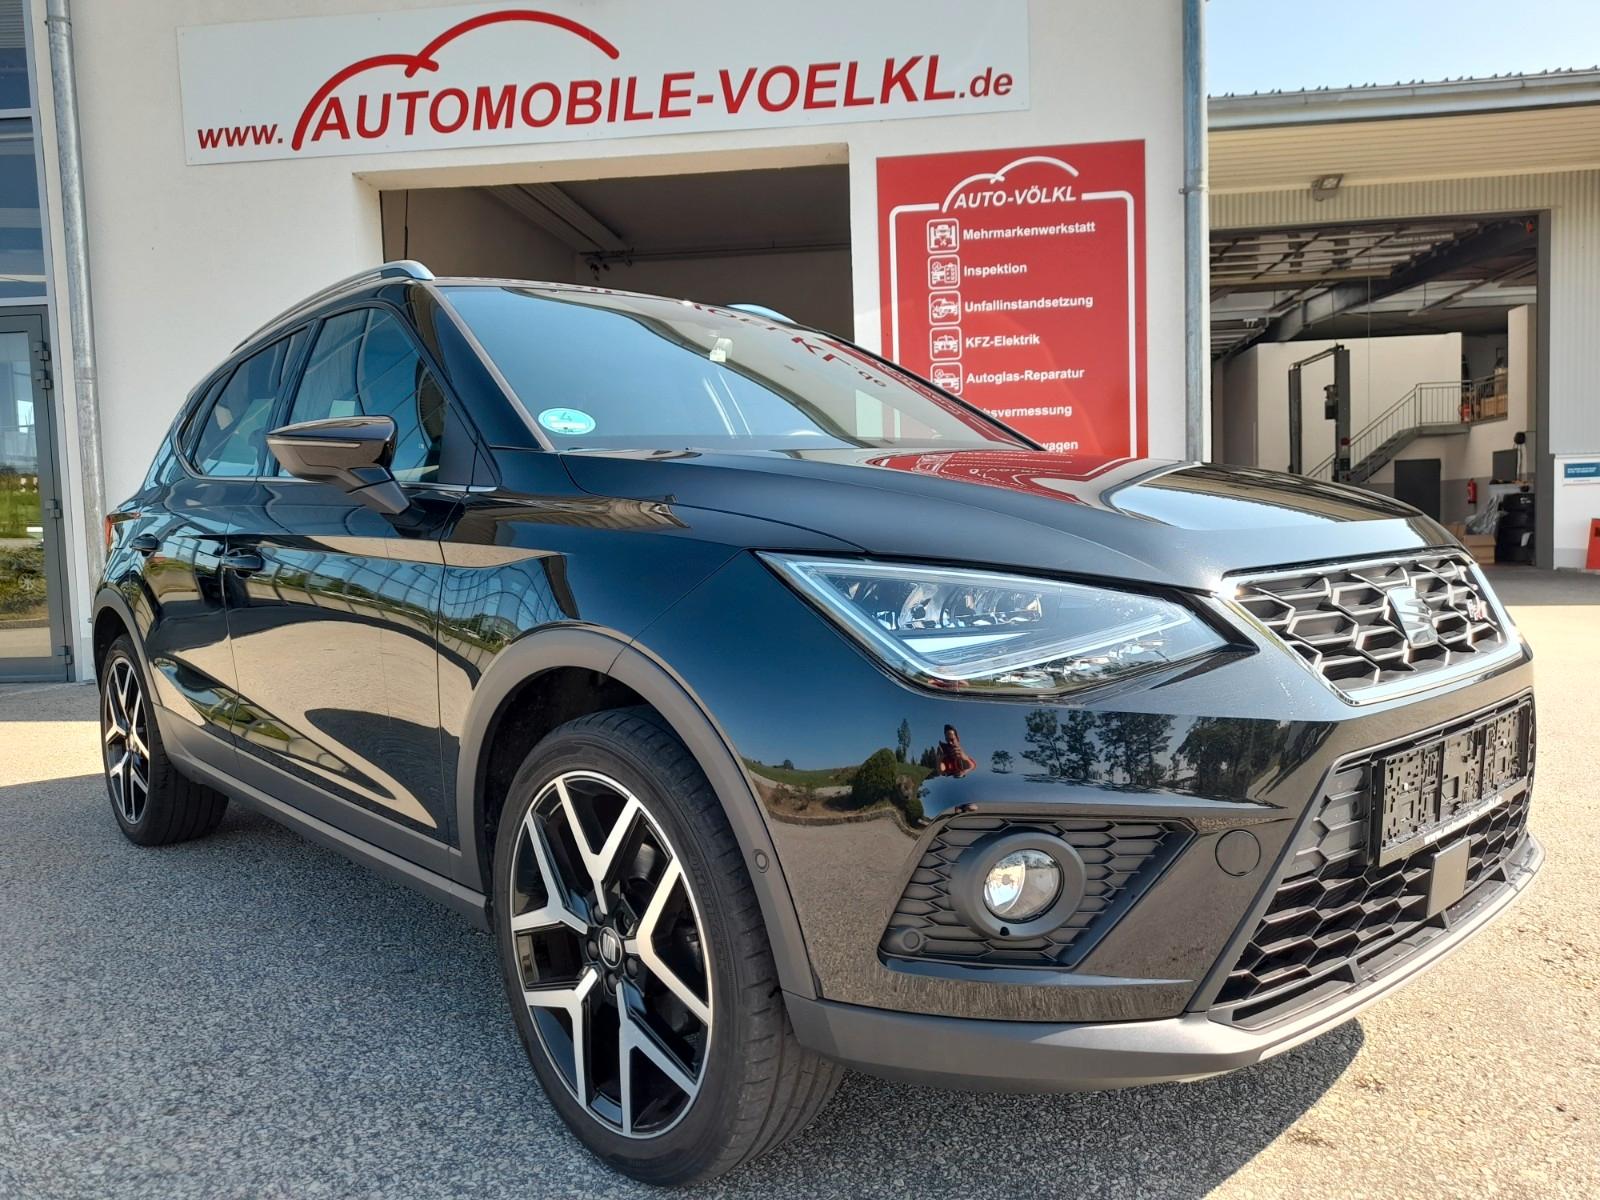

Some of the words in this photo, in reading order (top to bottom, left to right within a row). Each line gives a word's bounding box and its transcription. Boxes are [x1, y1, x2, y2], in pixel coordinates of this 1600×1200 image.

[953, 185, 1077, 209] AUTO-VÖLKL
[963, 221, 1096, 240] Mehrmarkenwerkstatt
[963, 263, 1028, 278] Inspektion
[964, 296, 1094, 313] Unfallinstandsetzung
[965, 333, 1041, 348] KFZ-Elektrik
[965, 368, 1085, 385] Autoglas-Reparatur
[983, 406, 1073, 417] svermessung
[1042, 441, 1079, 453] wagen
